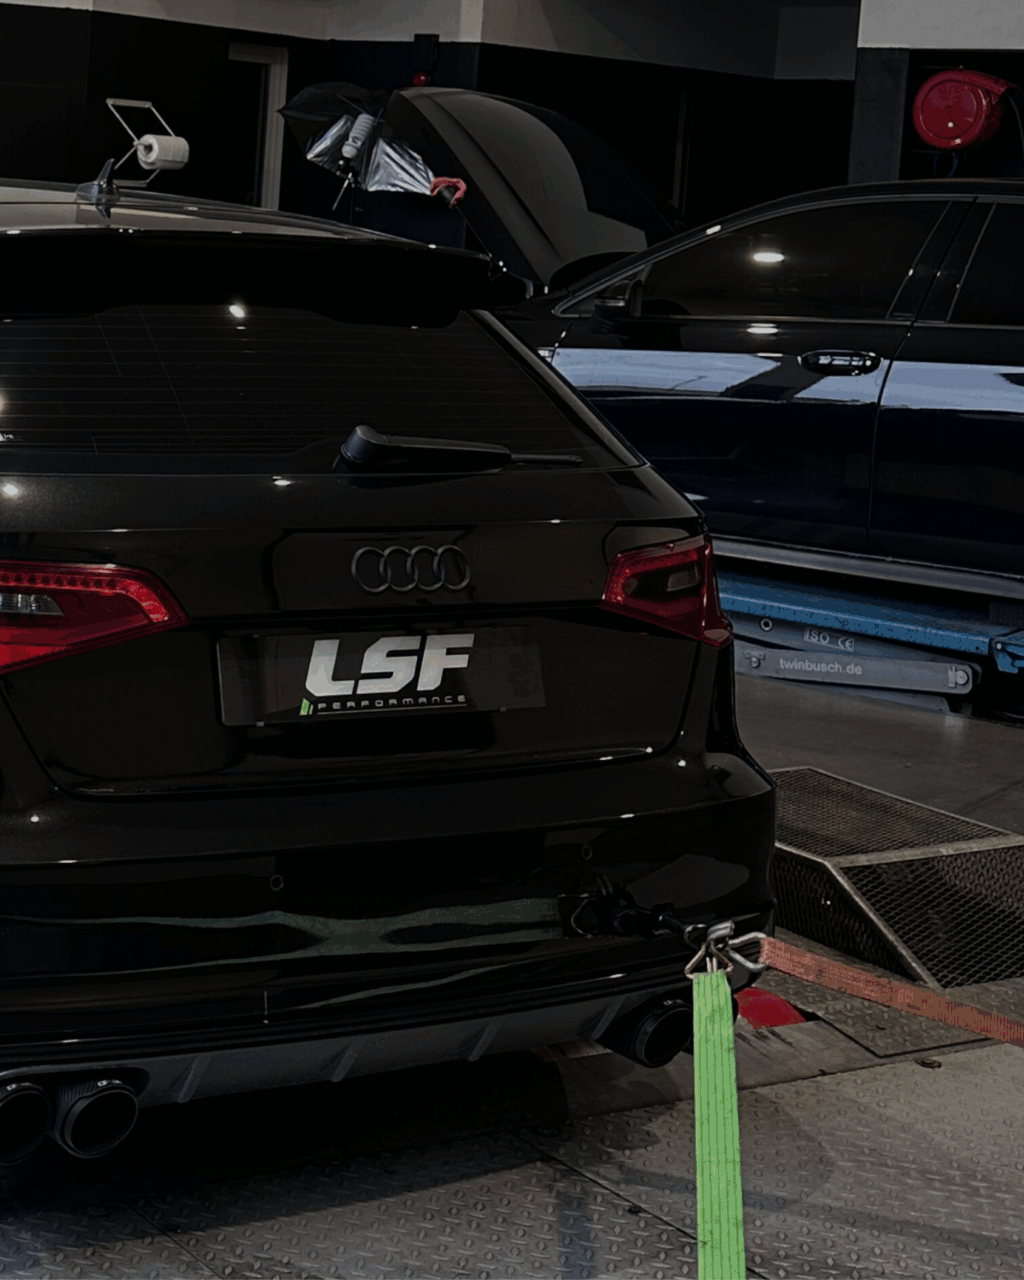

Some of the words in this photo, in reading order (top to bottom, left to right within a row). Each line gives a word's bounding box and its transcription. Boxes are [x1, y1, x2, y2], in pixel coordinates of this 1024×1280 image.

[806, 628, 830, 645] ISO
[305, 633, 475, 697] LSF
[779, 657, 863, 675] twinbusch.de
[317, 695, 466, 710] PERFORMANCE
